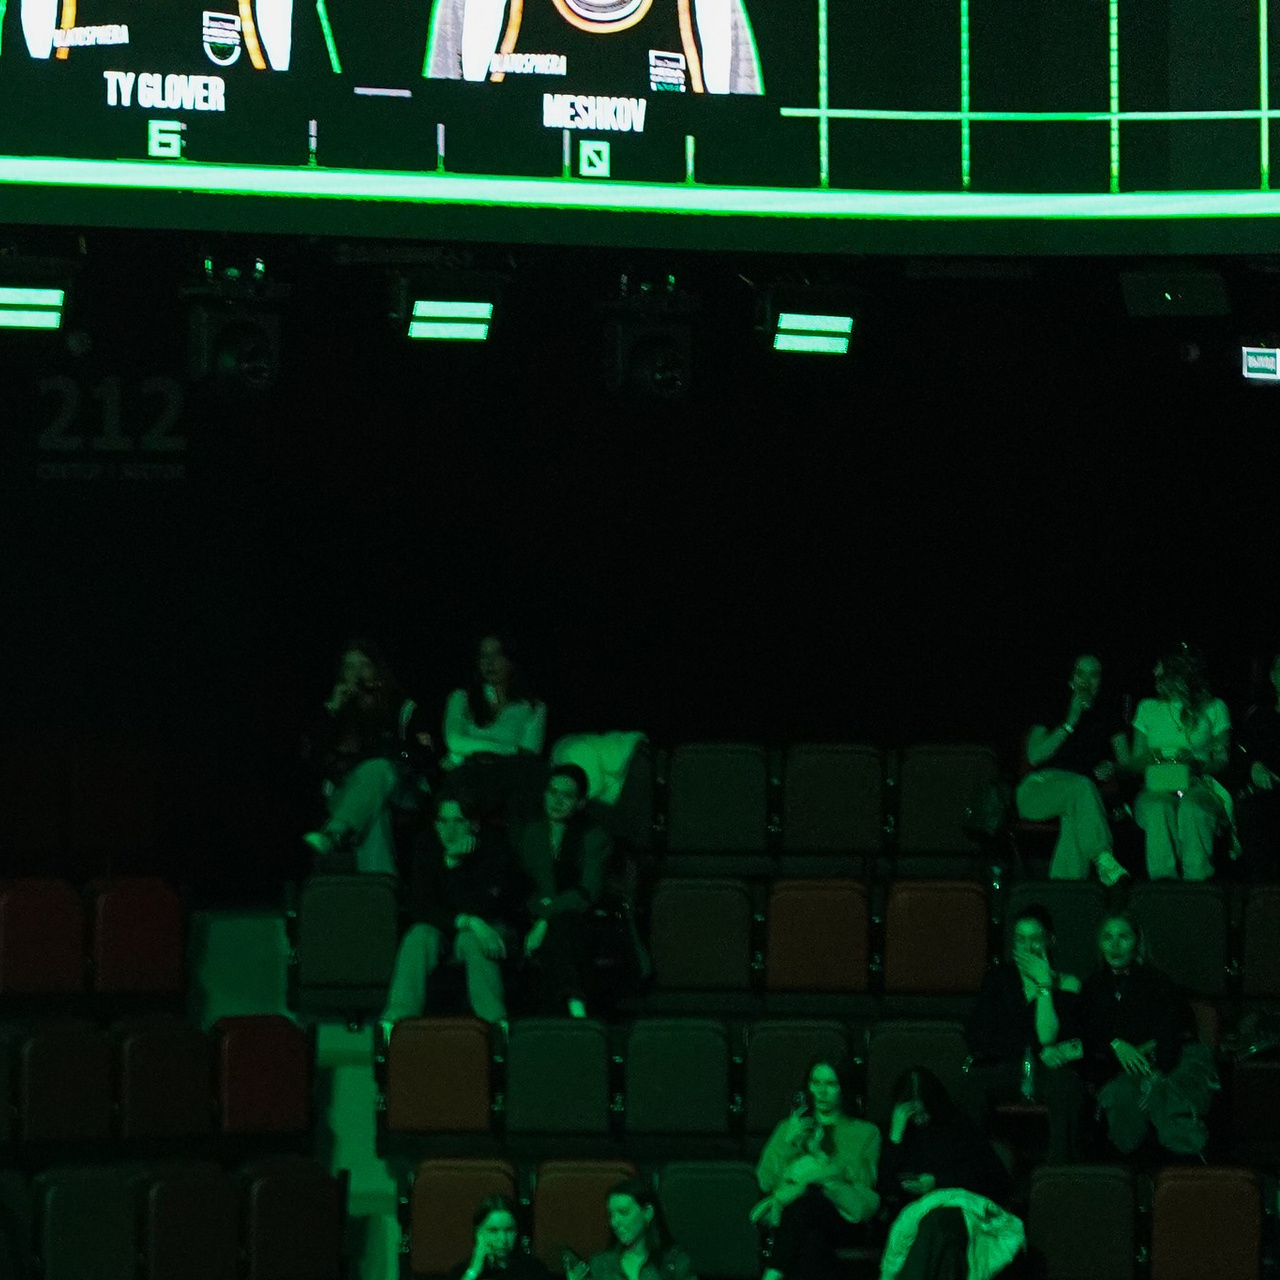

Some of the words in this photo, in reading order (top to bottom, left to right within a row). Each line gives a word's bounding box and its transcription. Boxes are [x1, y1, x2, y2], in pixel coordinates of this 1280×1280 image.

[103, 71, 135, 107] TY
[137, 73, 226, 112] GLOVER
[543, 93, 646, 132] MESHKOV
[148, 119, 182, 157] 6
[37, 376, 189, 451] 212
